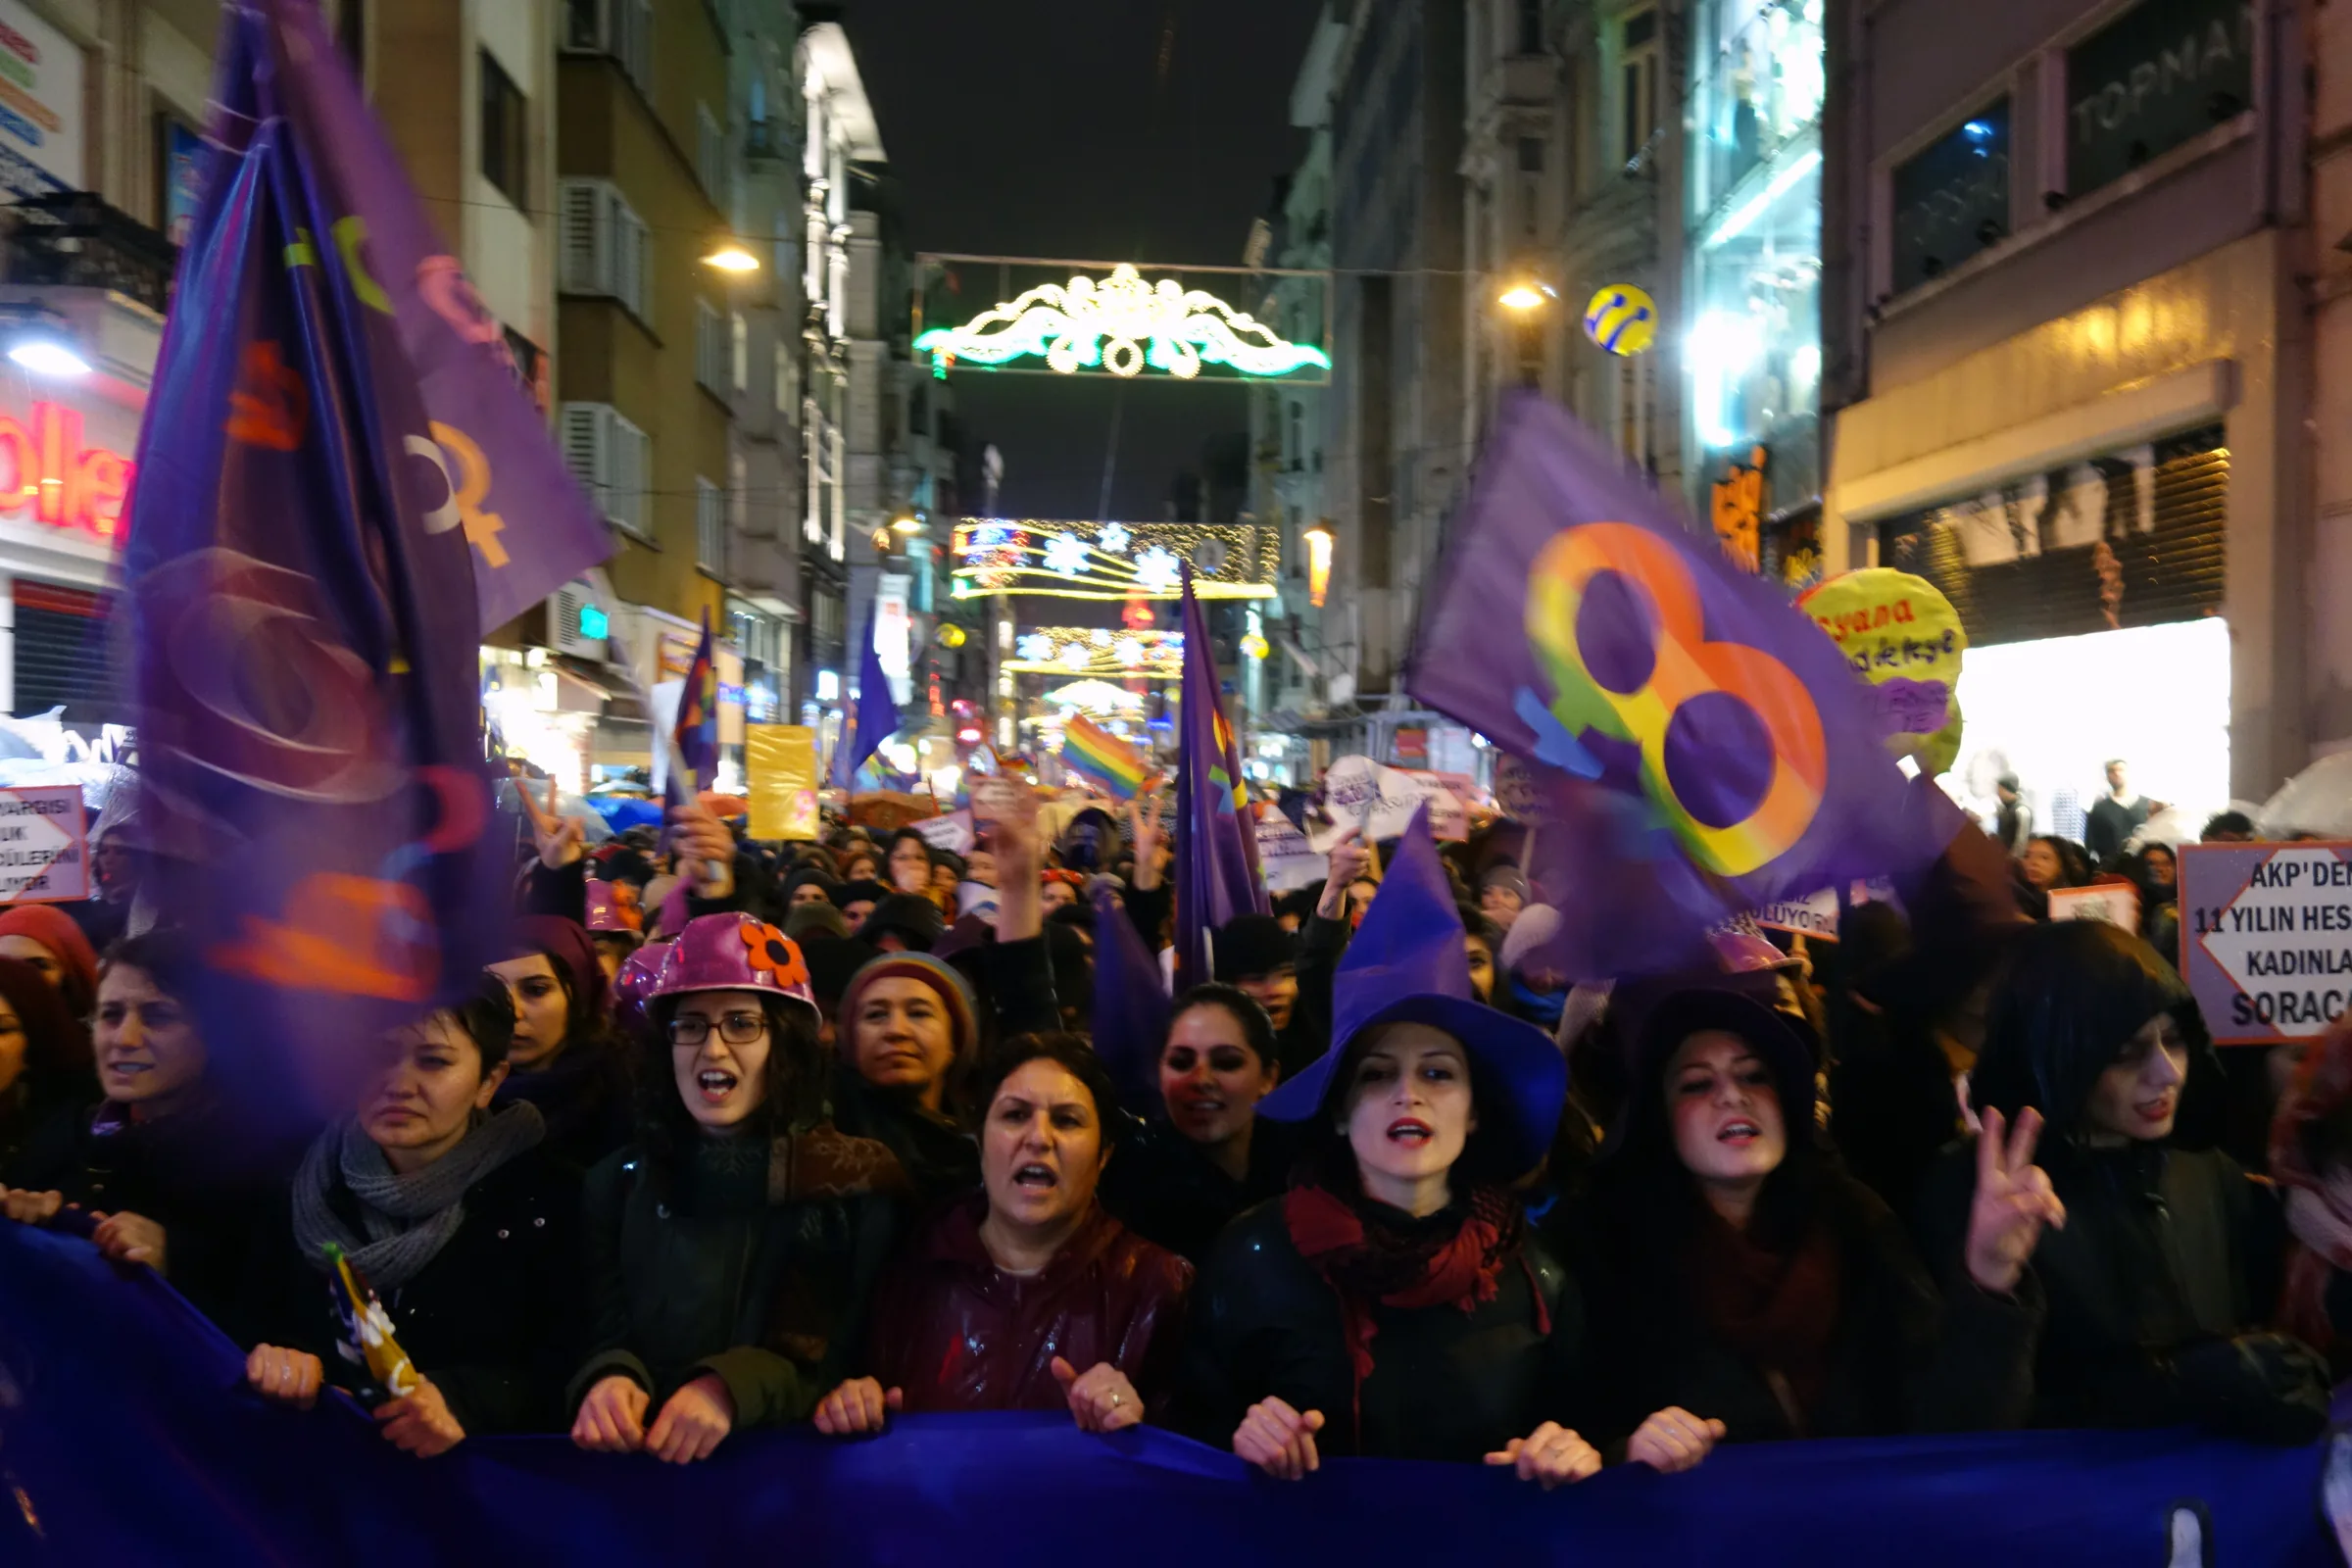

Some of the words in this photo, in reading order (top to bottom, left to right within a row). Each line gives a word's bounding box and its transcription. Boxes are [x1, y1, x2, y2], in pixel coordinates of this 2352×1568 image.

[2194, 906, 2225, 934] 11
[2230, 906, 2294, 932] YILIN
[2302, 904, 2352, 931] HES
[2246, 948, 2352, 976] KADINLA
[2230, 989, 2352, 1026] SORAC
